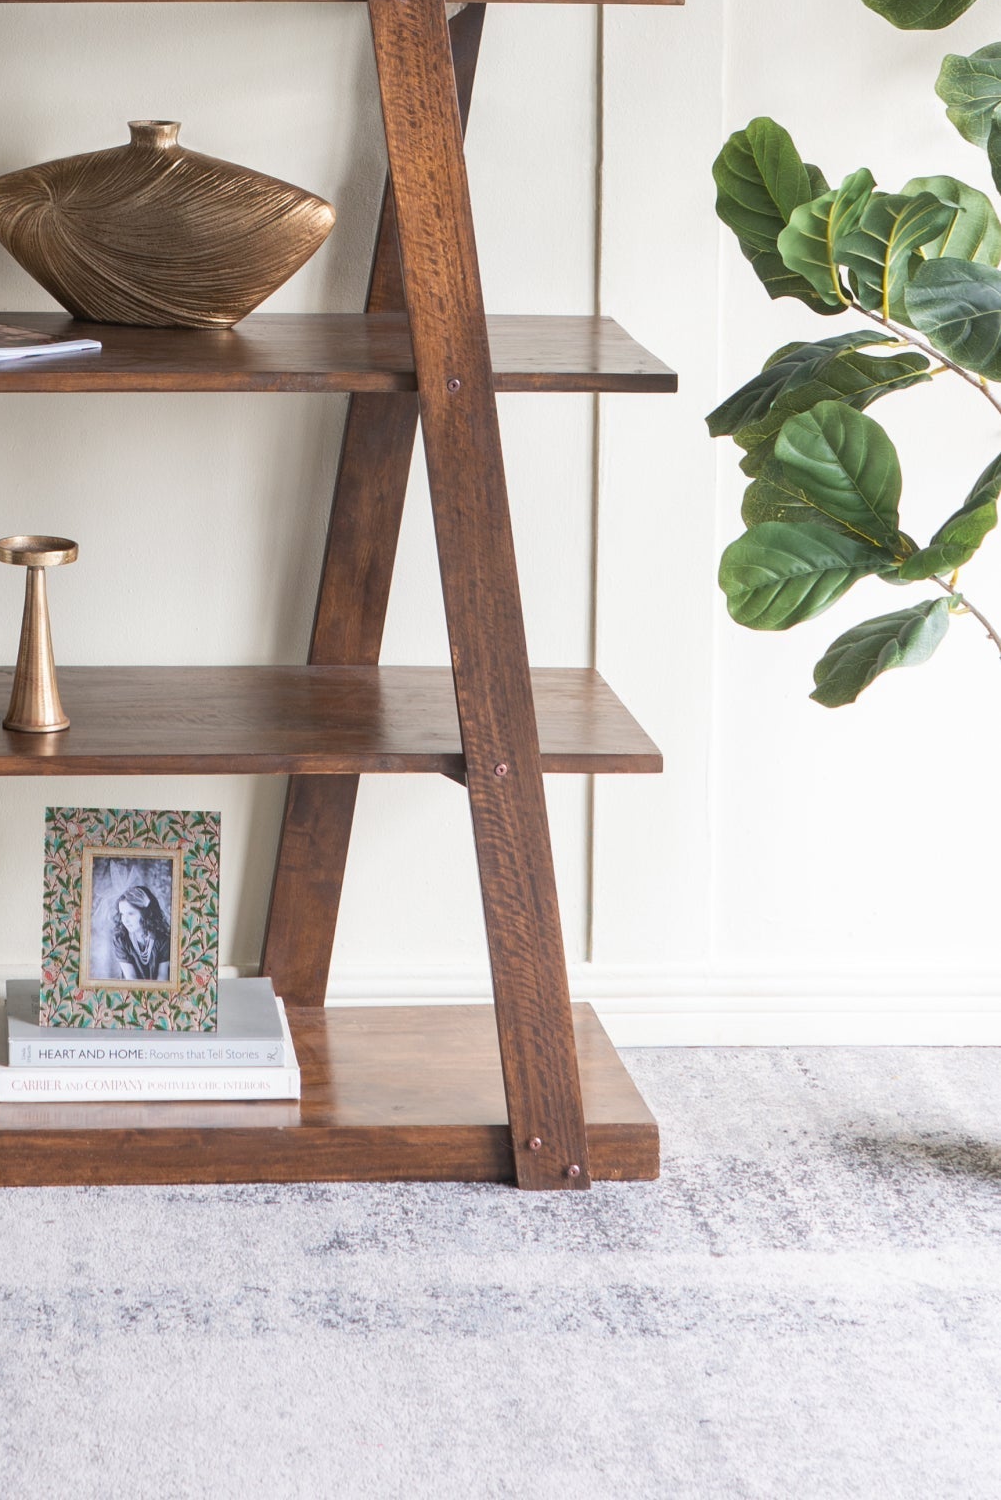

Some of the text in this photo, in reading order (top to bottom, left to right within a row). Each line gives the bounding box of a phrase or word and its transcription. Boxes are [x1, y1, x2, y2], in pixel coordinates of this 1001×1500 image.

[39, 1049, 75, 1059] HEART
[79, 1049, 105, 1059] AND
[109, 1049, 148, 1059] HOME:
[149, 1049, 184, 1059] Rooms
[186, 1049, 205, 1060] that
[207, 1048, 223, 1060] Tell
[227, 1048, 260, 1060] Stories
[11, 1079, 271, 1091] CARRIER AND COMPANY POSITIVELY CHIC INTERIORS
